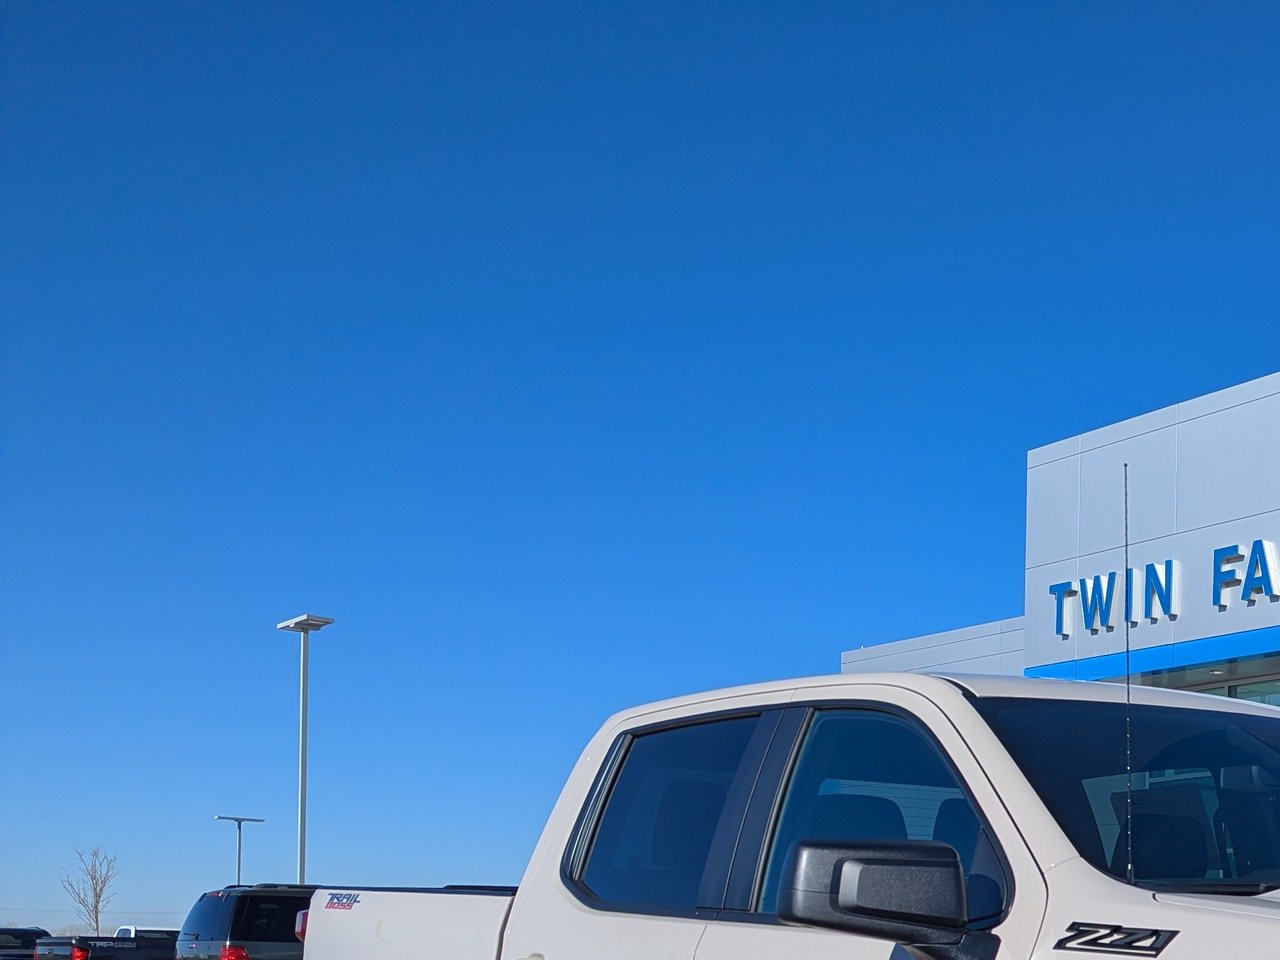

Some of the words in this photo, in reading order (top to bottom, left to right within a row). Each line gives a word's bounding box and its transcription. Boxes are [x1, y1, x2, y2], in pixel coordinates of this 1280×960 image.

[1049, 559, 1177, 639] TWIN
[325, 902, 354, 910] BOSS
[328, 893, 361, 903] TRAIL
[1053, 921, 1181, 959] Z71
